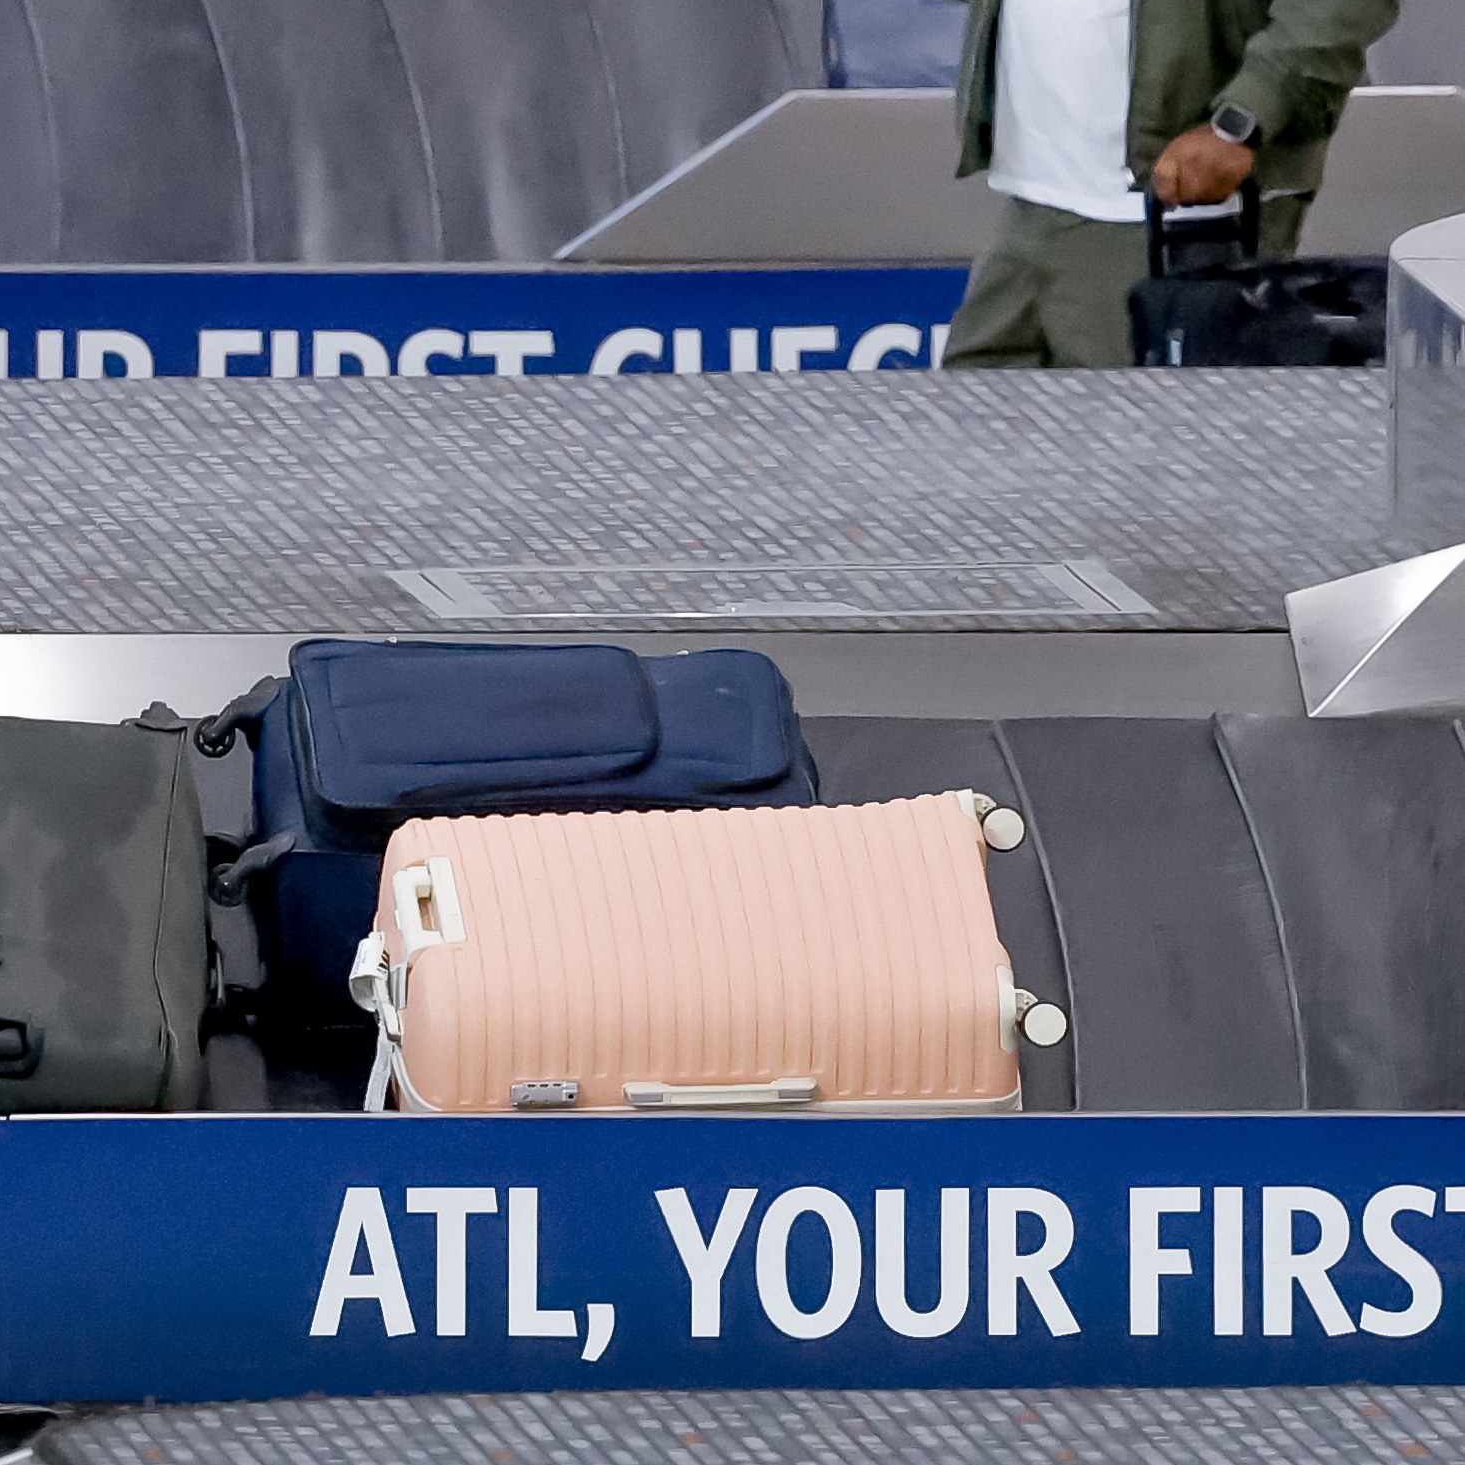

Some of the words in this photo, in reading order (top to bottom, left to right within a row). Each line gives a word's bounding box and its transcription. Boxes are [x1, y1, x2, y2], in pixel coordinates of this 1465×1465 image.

[309, 1187, 615, 1362] ATL,
[653, 1186, 1082, 1340] YOUR
[1129, 1184, 1465, 1337] FIRS
